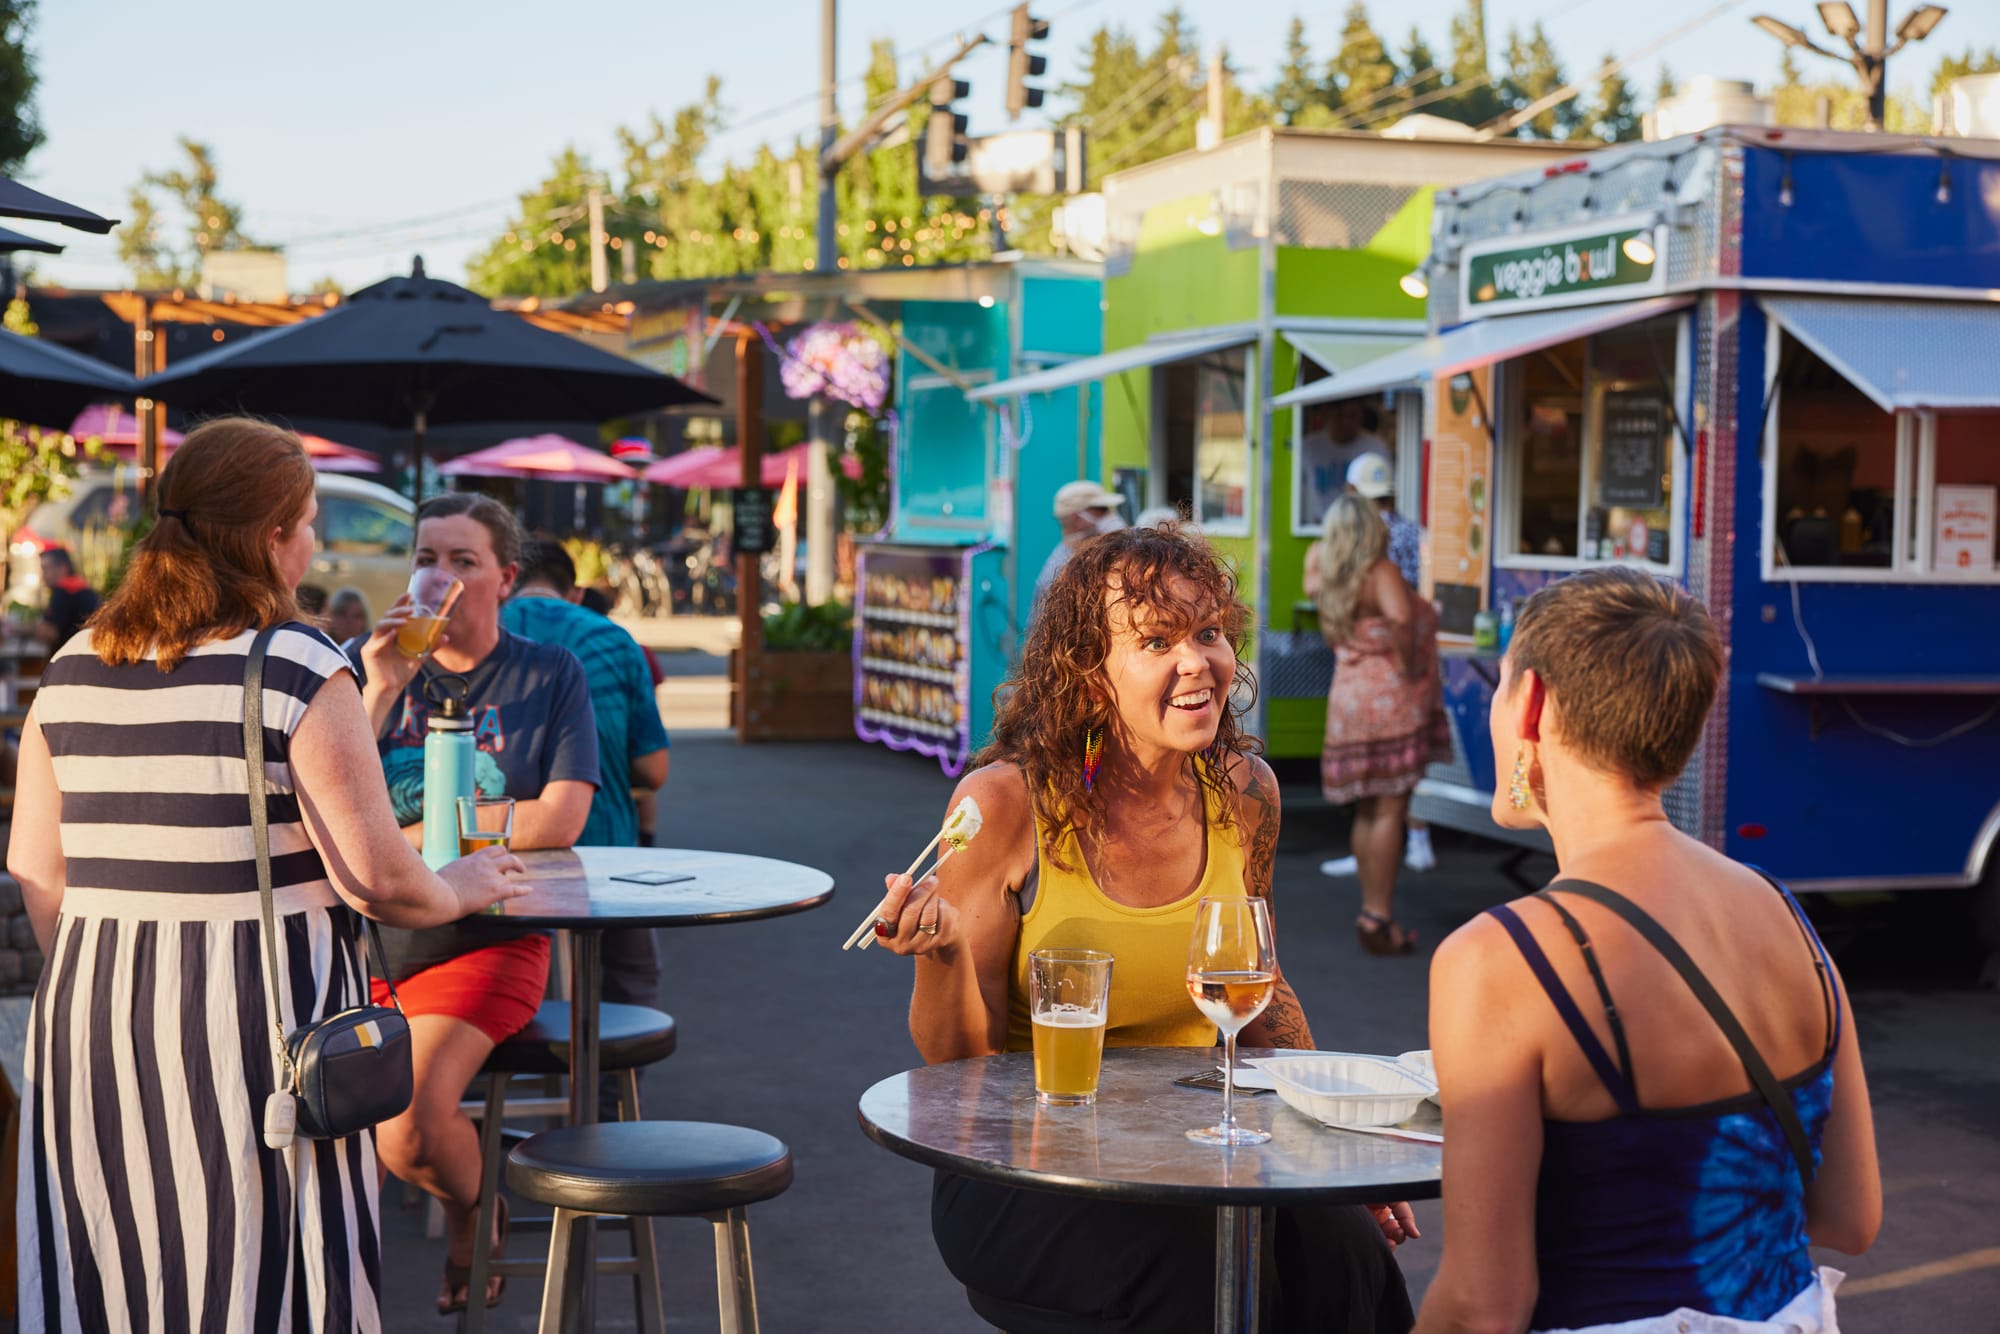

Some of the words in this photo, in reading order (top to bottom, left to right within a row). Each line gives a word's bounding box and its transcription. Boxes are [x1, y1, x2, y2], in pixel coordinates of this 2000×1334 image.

[1493, 248, 1563, 298] veggie
[1565, 237, 1616, 284] bowl
[390, 694, 505, 753] KA
